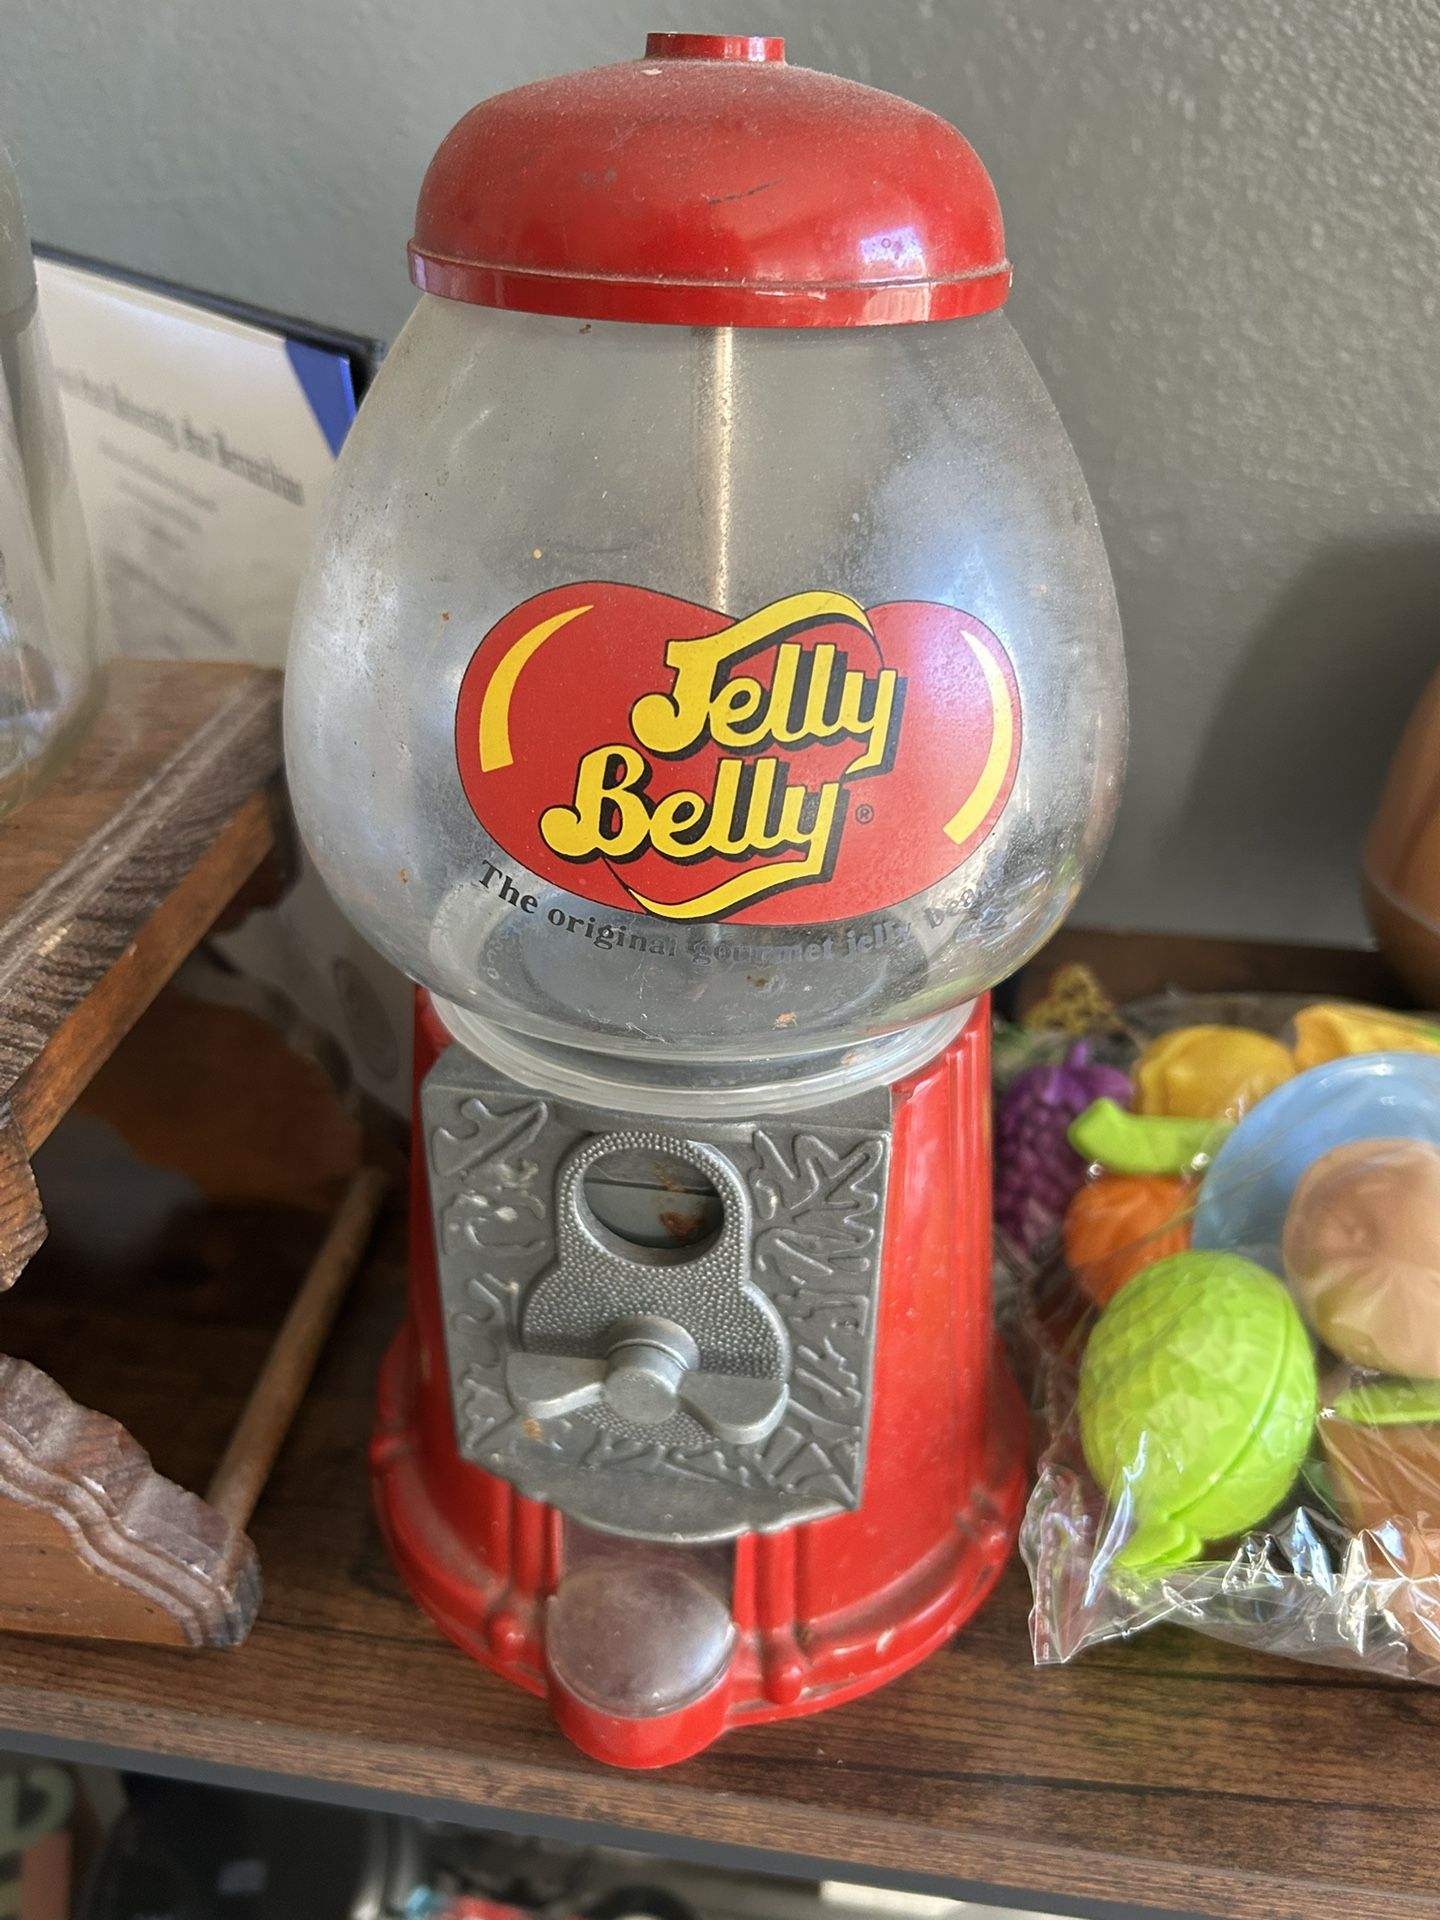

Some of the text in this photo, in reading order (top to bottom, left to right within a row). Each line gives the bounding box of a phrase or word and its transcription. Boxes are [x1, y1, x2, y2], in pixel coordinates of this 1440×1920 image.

[630, 589, 908, 784] Jelly
[476, 860, 538, 914] The
[547, 907, 677, 950] original
[540, 743, 850, 925] Belly
